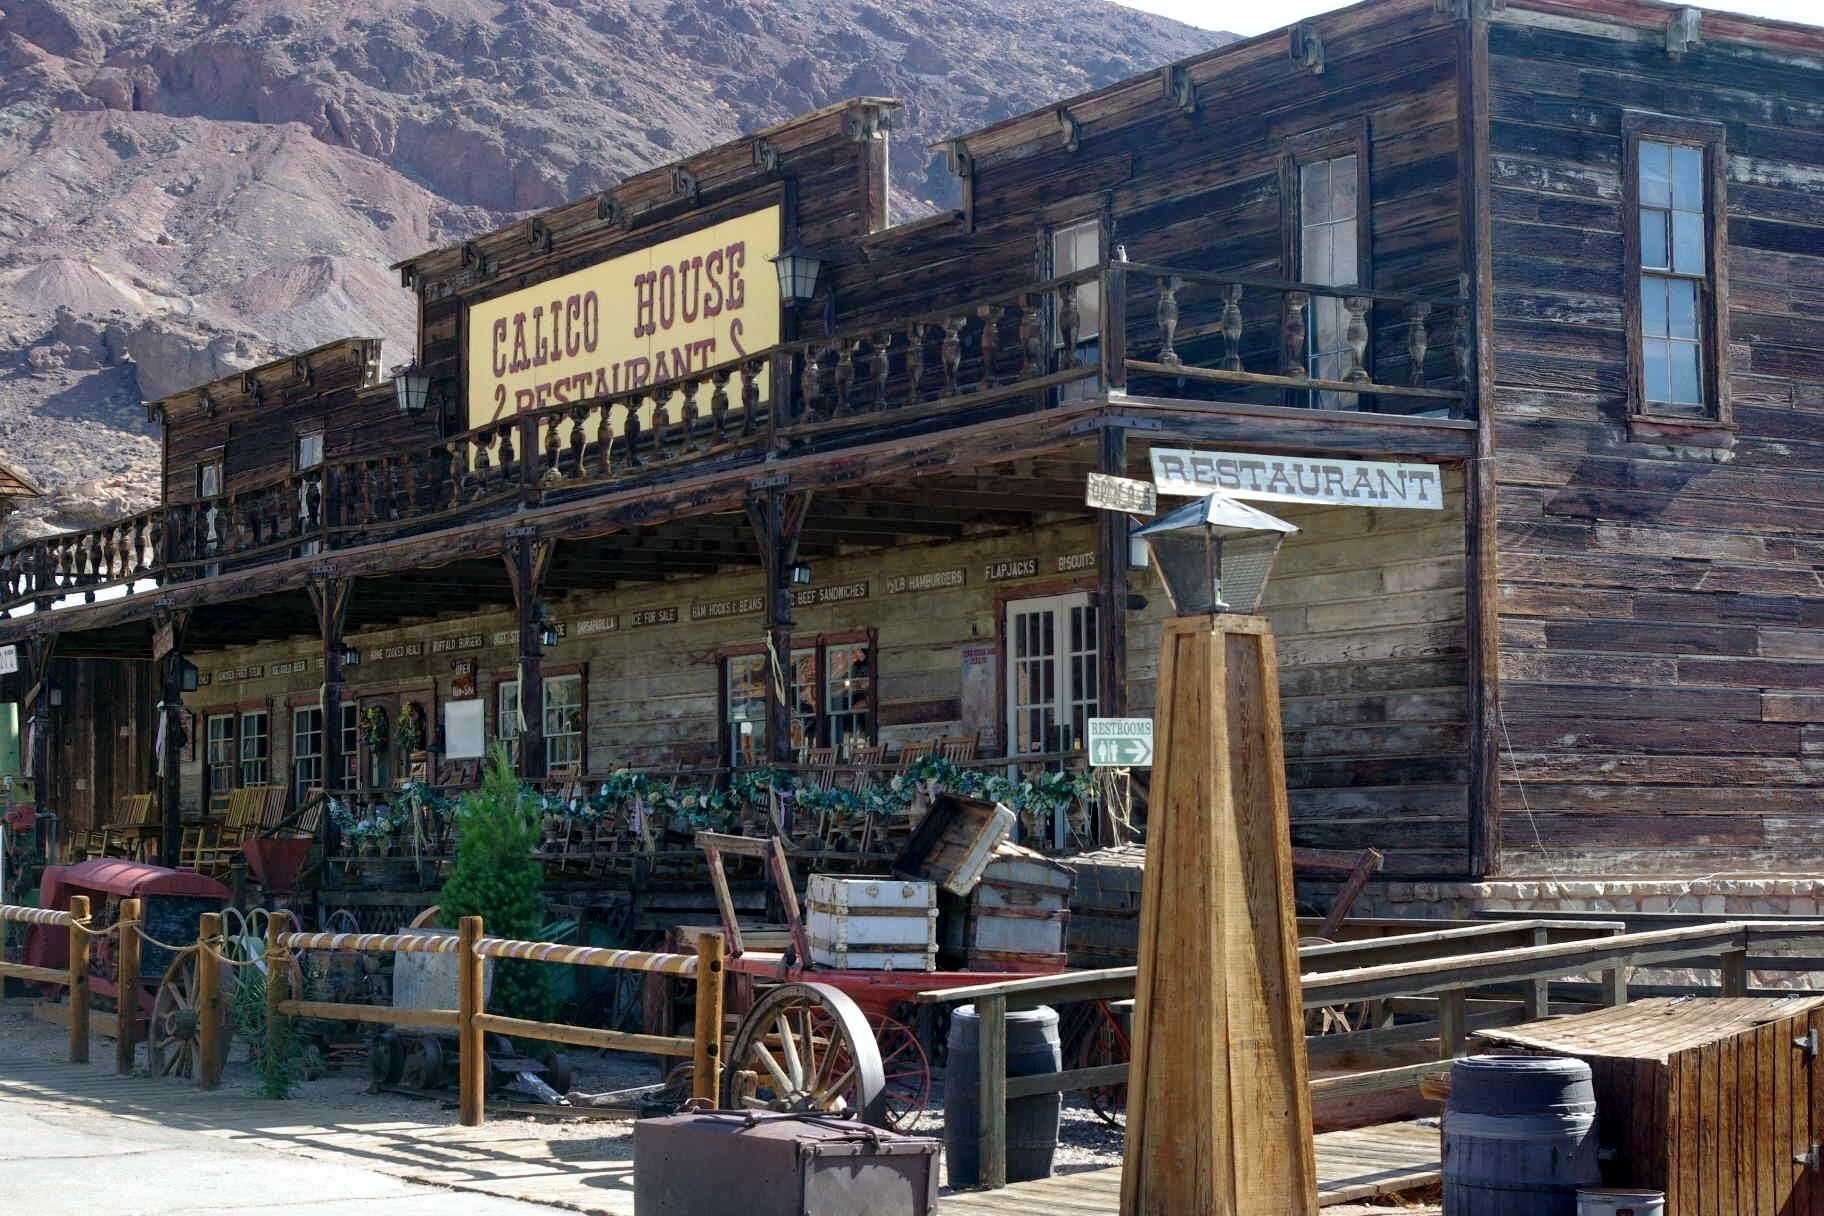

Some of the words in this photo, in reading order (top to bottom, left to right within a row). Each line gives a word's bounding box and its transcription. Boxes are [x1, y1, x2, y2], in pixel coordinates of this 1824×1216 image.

[492, 290, 599, 378] CALICO
[633, 241, 746, 338] HOUSE
[1159, 454, 1436, 501] RESTAURANT
[909, 569, 963, 592] HAMBURGERS
[985, 559, 1035, 580] FLAPJACKS
[819, 583, 865, 601] SANDWICHES
[1090, 721, 1152, 736] RESTROOMS
